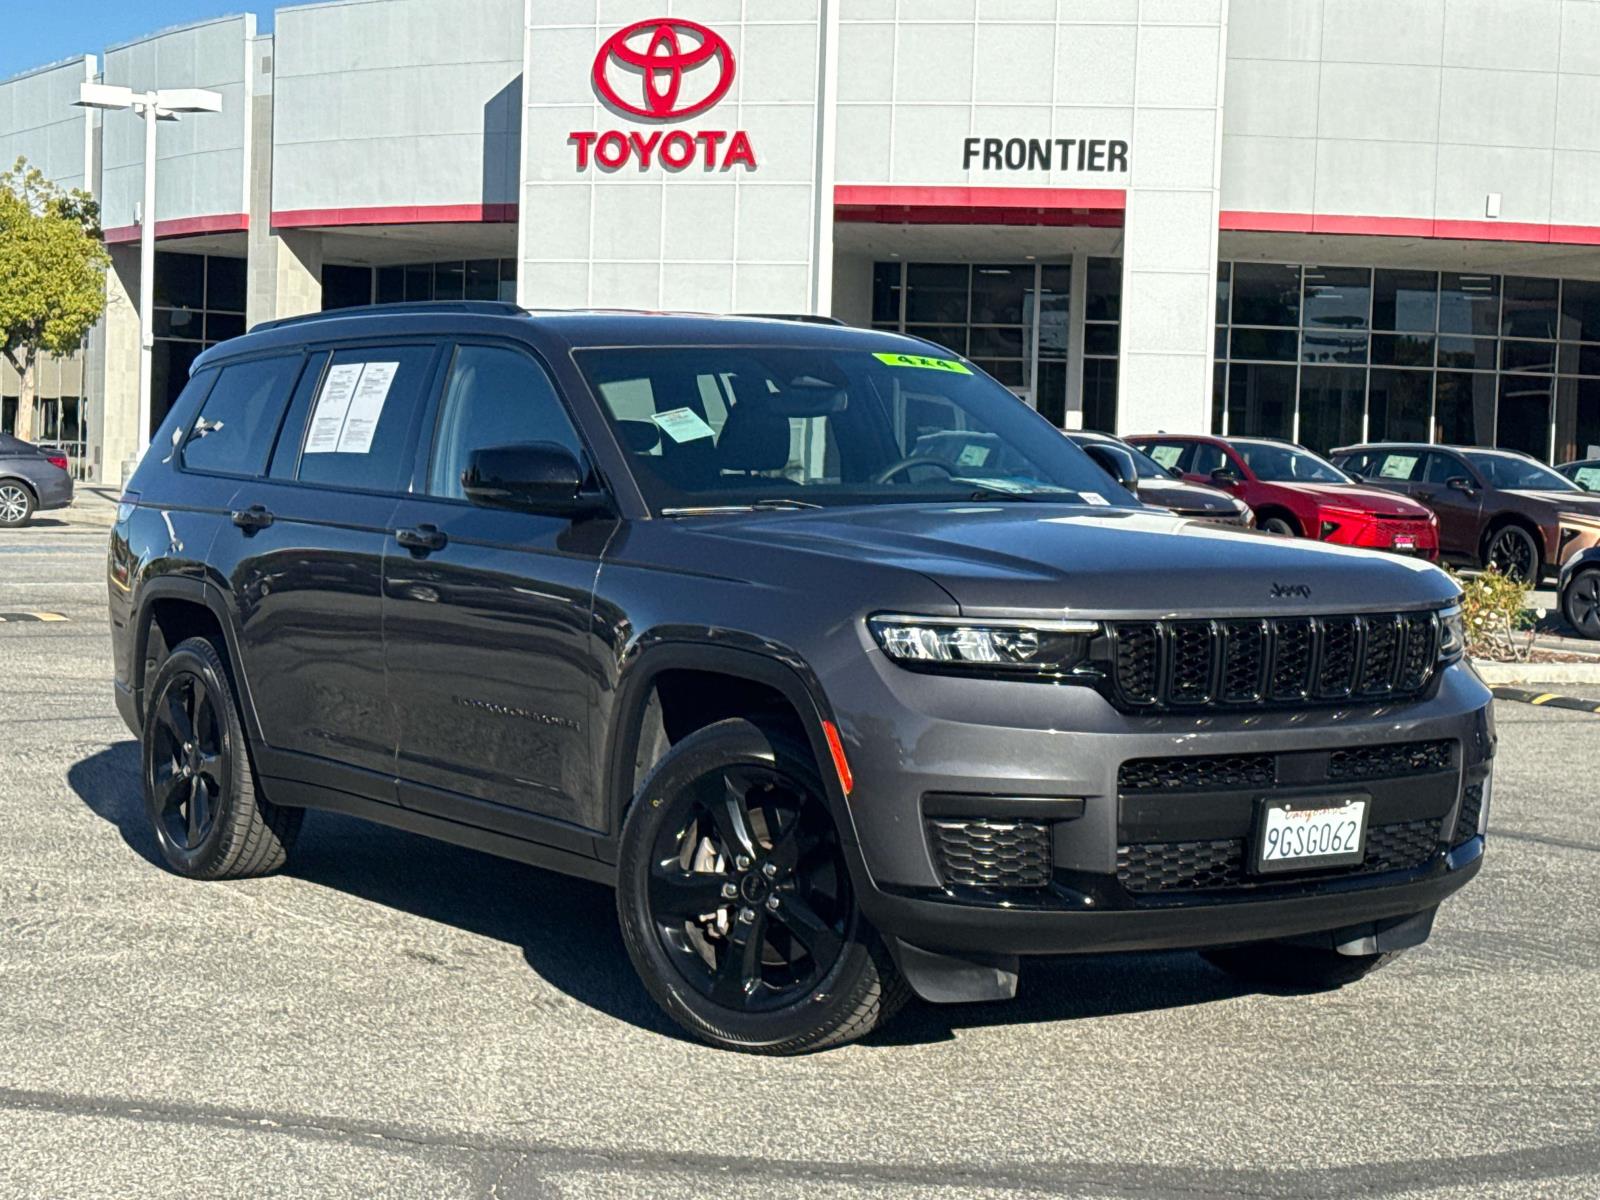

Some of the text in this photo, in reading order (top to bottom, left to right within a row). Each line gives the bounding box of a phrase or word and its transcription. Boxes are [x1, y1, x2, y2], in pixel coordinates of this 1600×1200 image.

[568, 130, 757, 172] TOYOTA
[962, 137, 1129, 172] FRONTIER
[1270, 582, 1312, 599] Jeep
[1266, 820, 1357, 859] 9GSG062
